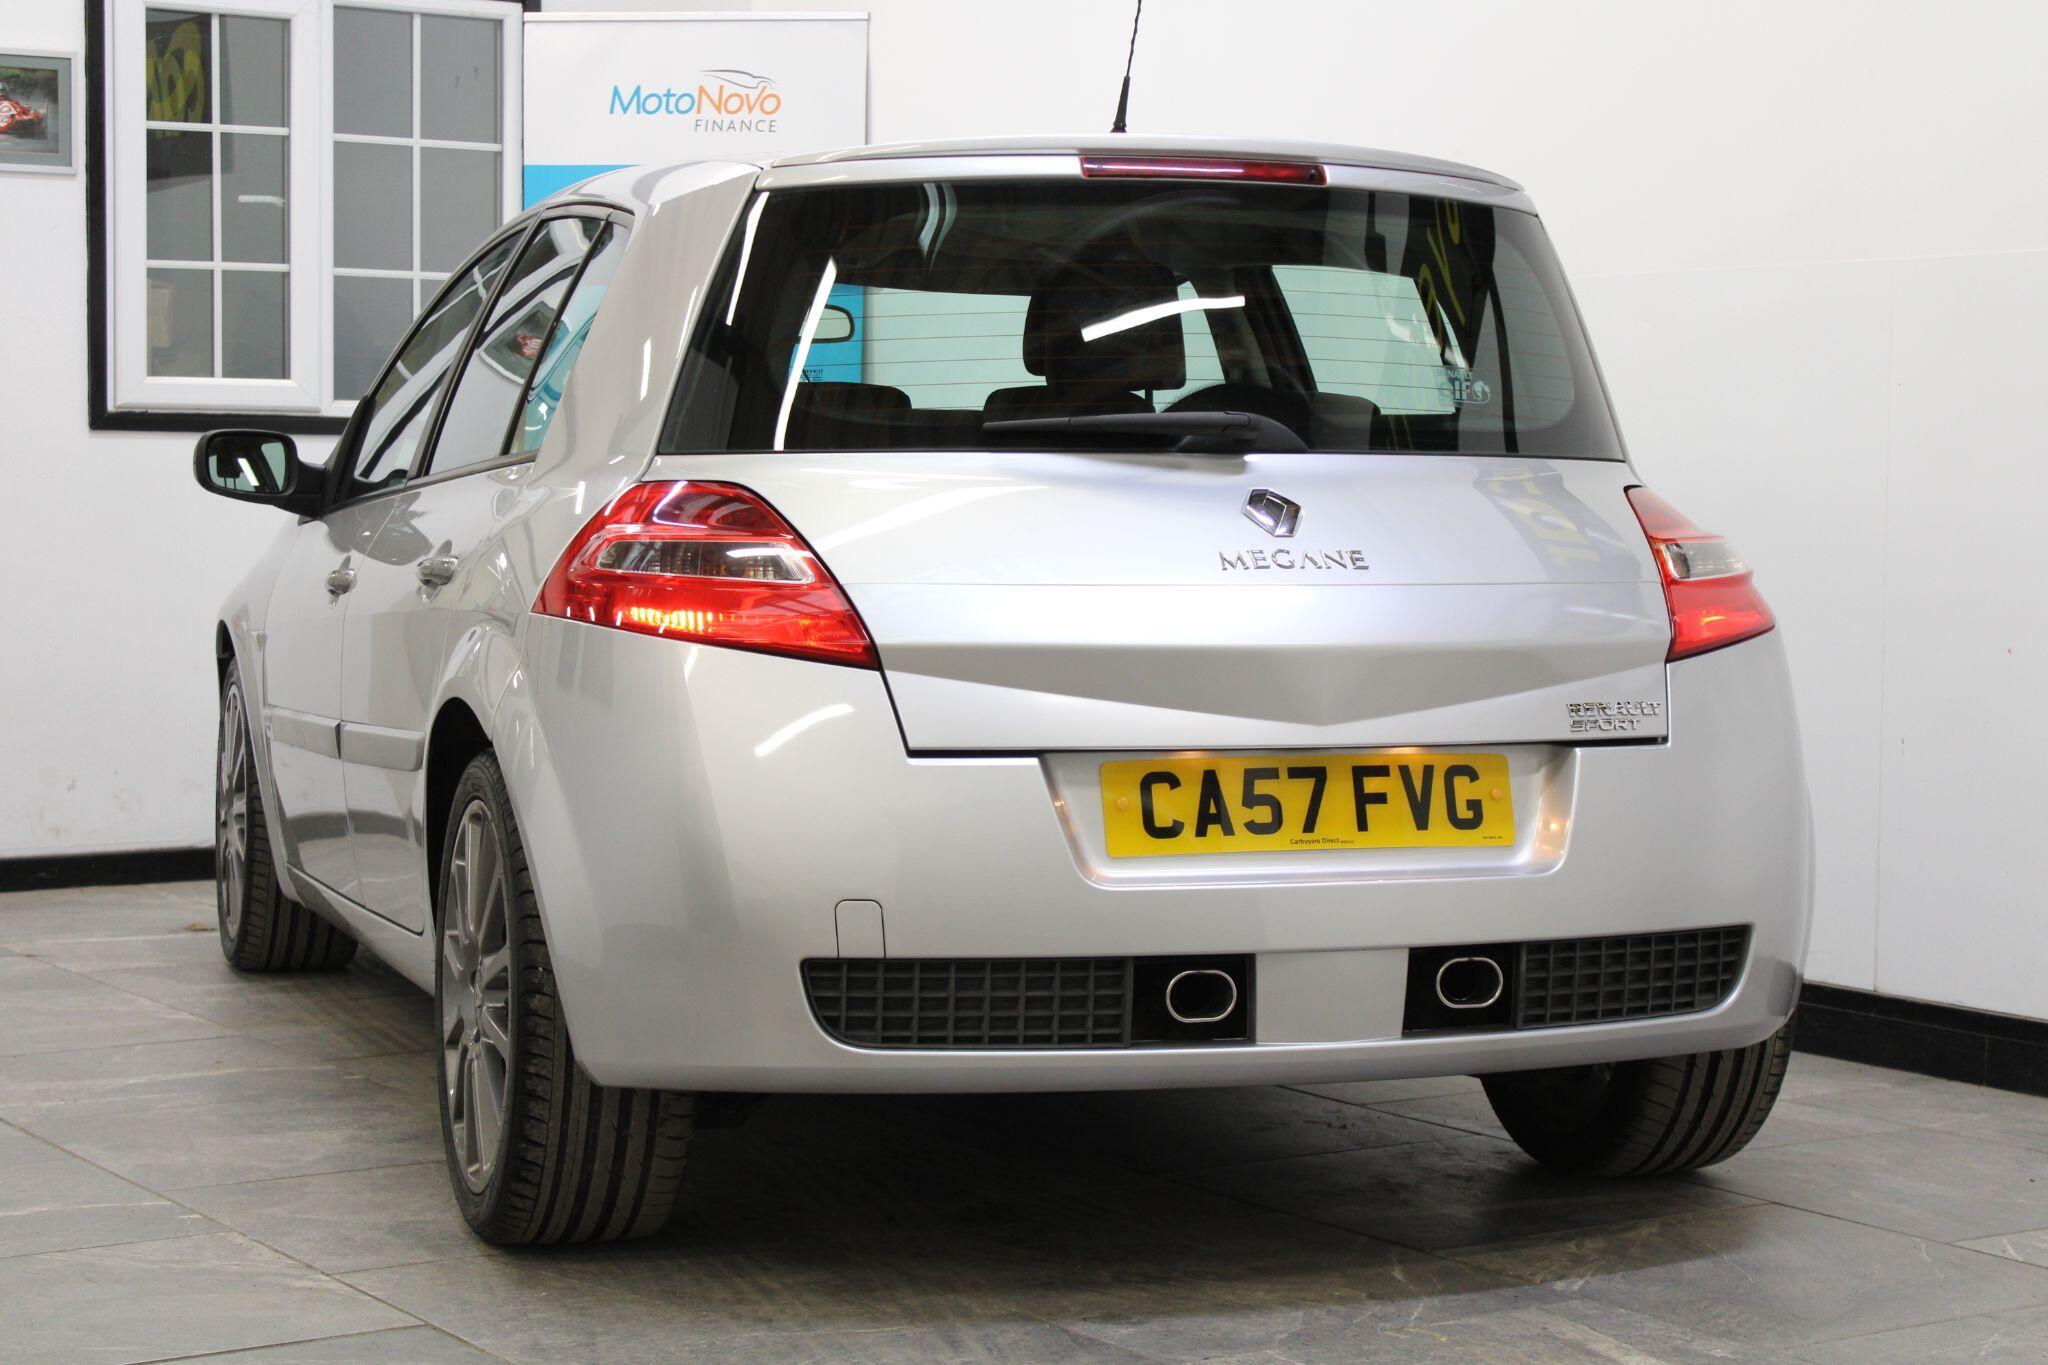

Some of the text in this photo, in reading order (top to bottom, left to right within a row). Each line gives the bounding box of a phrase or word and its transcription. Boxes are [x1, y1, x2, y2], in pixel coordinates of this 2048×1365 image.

[609, 85, 781, 115] MotoNovo
[695, 119, 777, 132] FINANCE
[1219, 548, 1369, 570] MEGANE
[1567, 701, 1660, 717] RENAULT
[1570, 718, 1640, 732] SPORT
[1139, 764, 1484, 839] CA57 FVG
